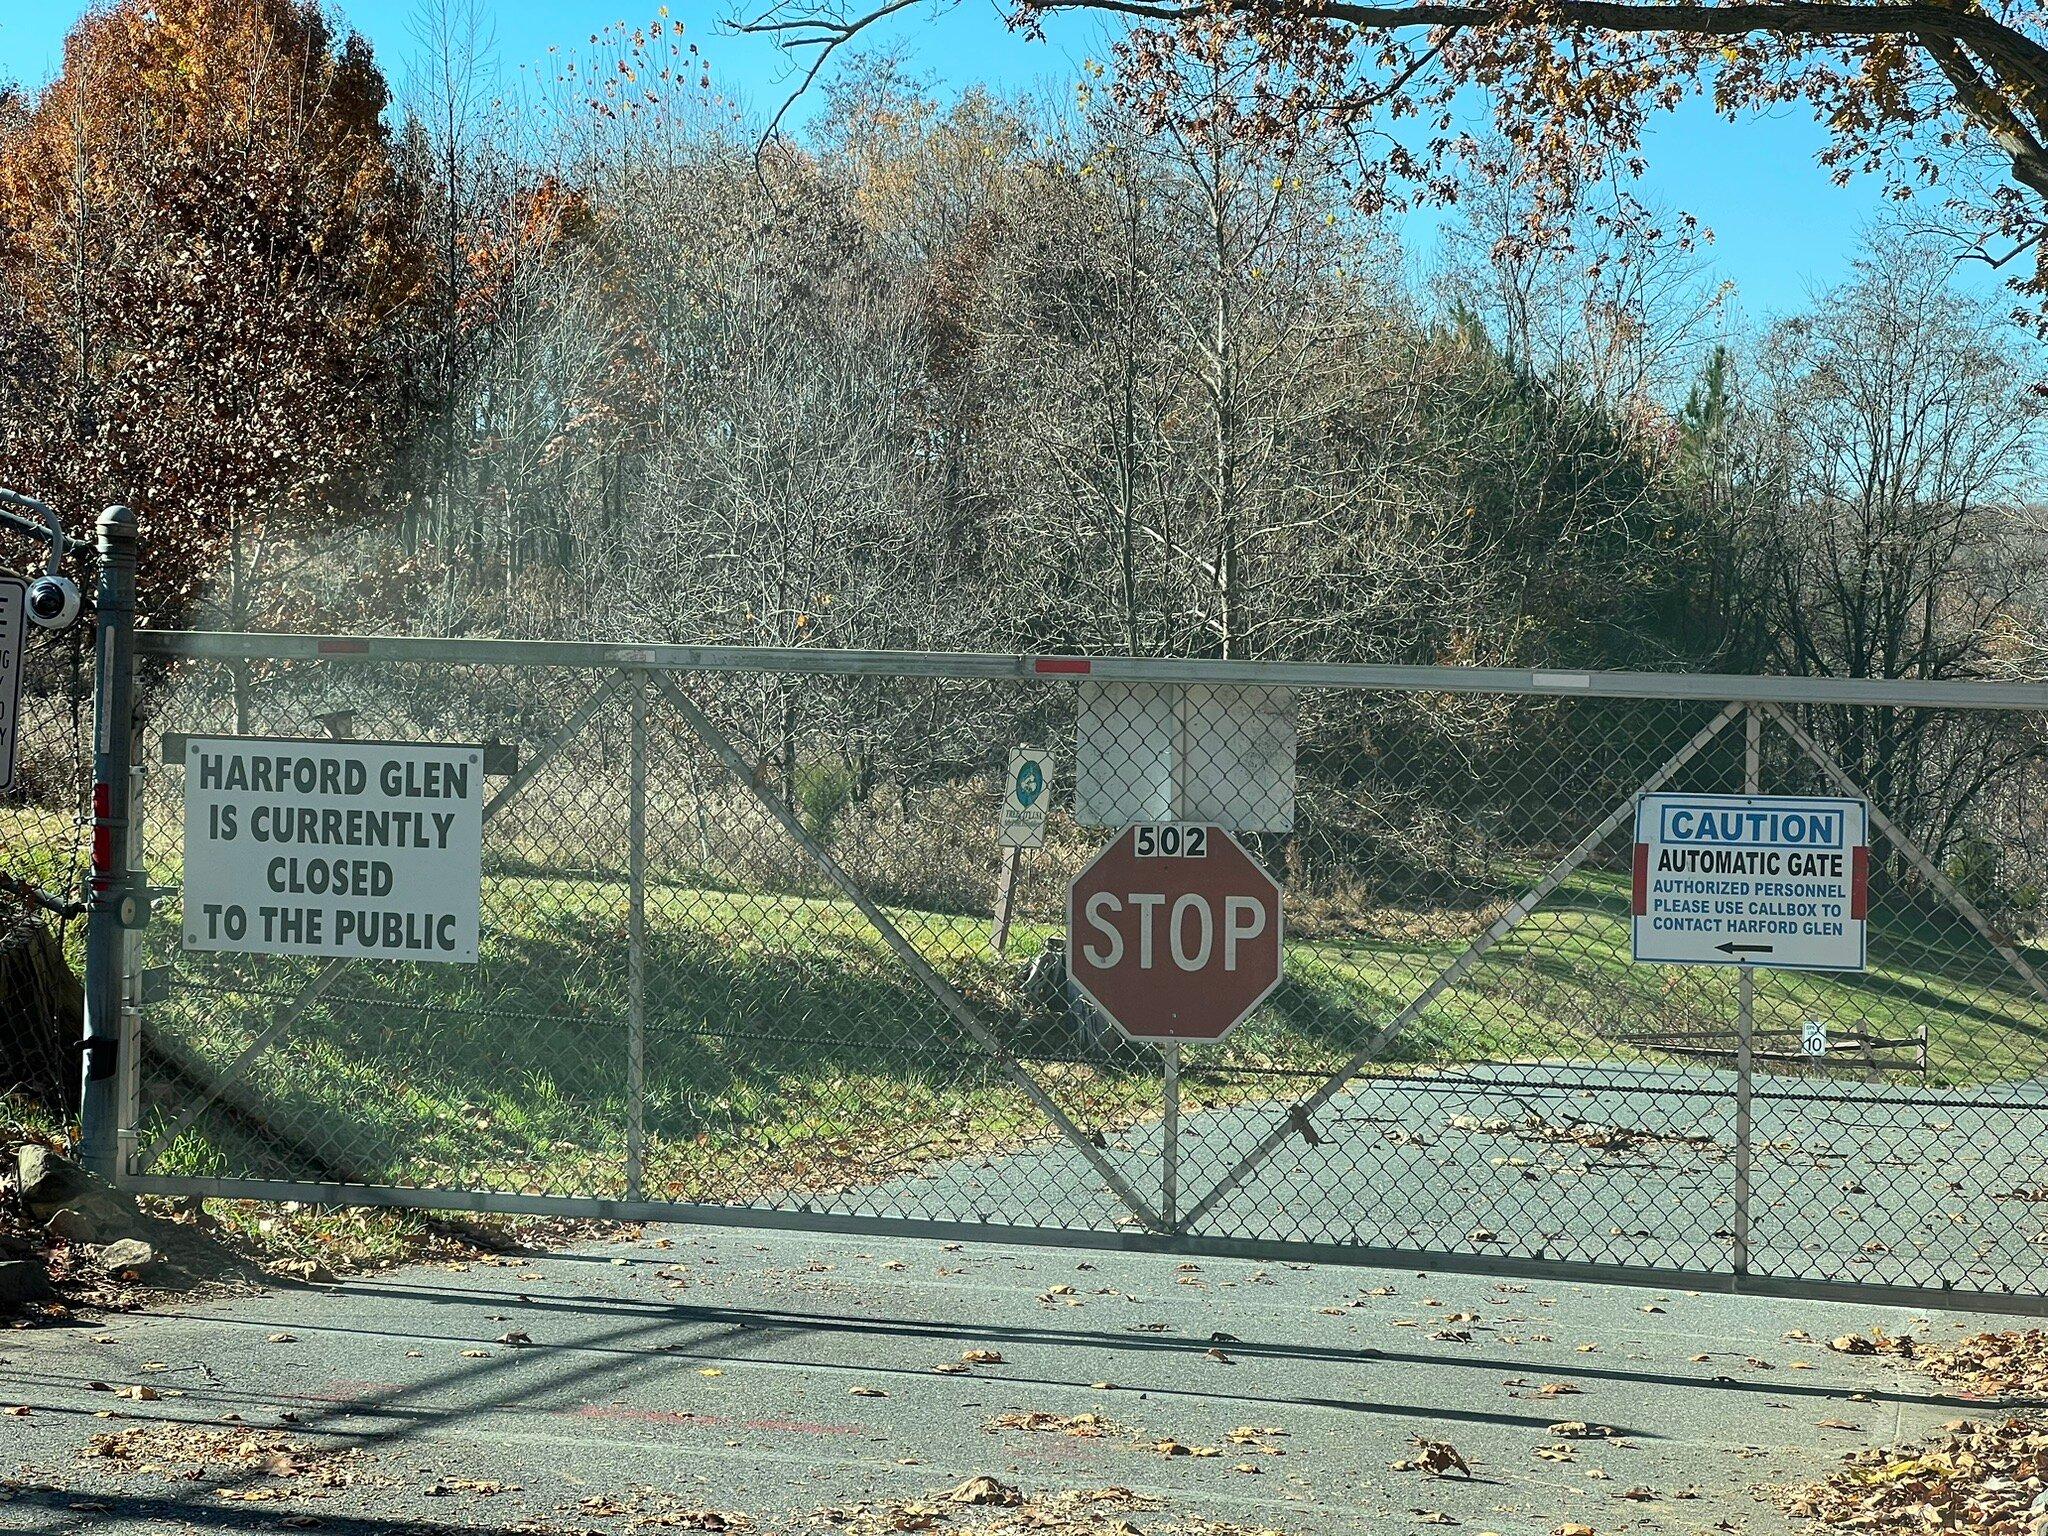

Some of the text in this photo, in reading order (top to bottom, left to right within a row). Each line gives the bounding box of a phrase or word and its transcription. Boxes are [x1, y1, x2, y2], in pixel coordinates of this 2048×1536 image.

[199, 753, 469, 800] HARFORD GLEN
[209, 804, 457, 850] IS CURRENTLY
[1137, 826, 1206, 857] 502
[1671, 810, 1833, 844] CAUTION
[266, 856, 395, 898] CLOSED
[1657, 848, 1843, 878] AUTOMATIC GATE
[1652, 878, 1847, 899] AUTHORIZED PERSONNEL
[1653, 898, 1842, 918] PLEASE USE CALLBOX TO
[202, 903, 458, 952] TO THE PUBLIC
[1082, 891, 1267, 972] STOP
[1652, 916, 1843, 936] CONTACT HARFORD GLEN
[1807, 1037, 1822, 1051] 10
